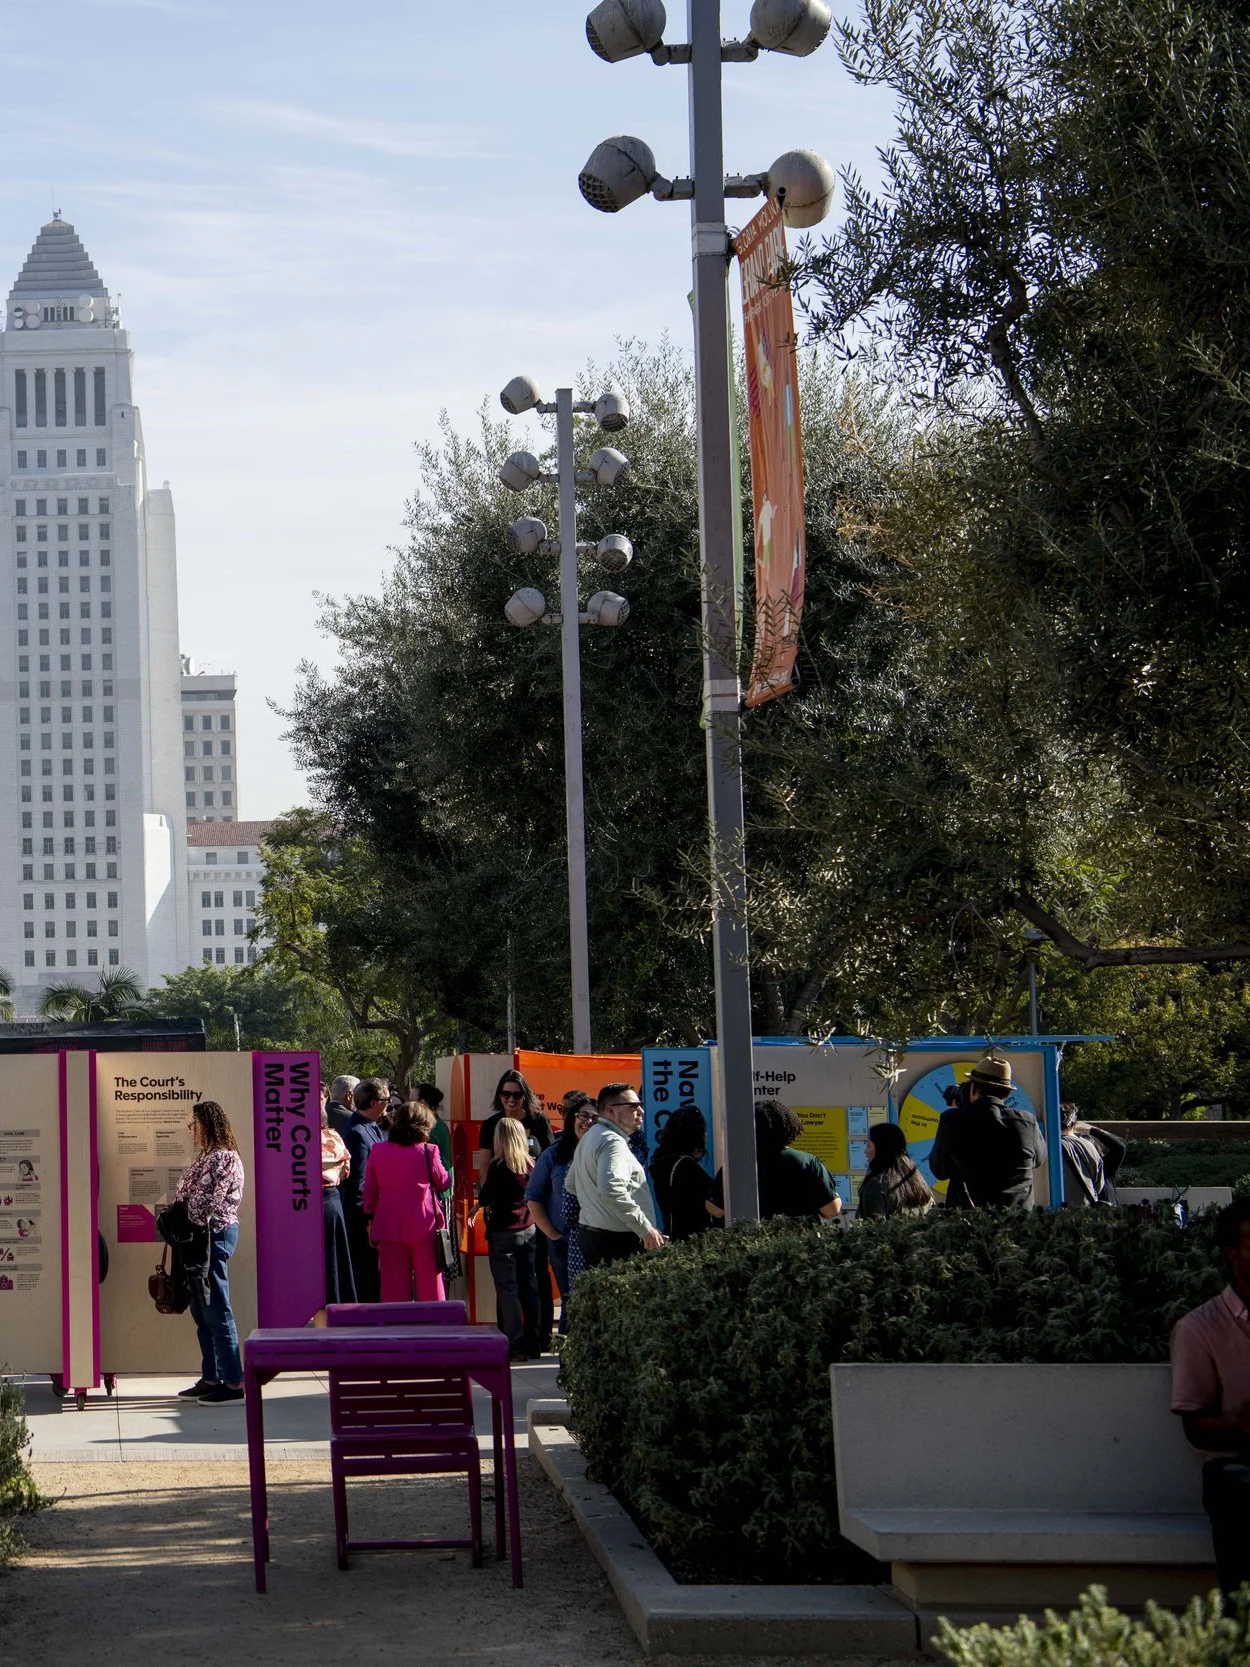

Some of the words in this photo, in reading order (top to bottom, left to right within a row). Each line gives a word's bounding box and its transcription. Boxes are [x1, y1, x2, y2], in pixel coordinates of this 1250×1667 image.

[114, 1076, 137, 1087] The
[140, 1076, 185, 1087] Court's
[114, 1089, 203, 1102] Responsibility
[286, 1062, 310, 1118] Why
[652, 1060, 673, 1102] the
[754, 1085, 780, 1096] nter
[264, 1063, 285, 1153] Matter
[290, 1124, 312, 1212] Courts
